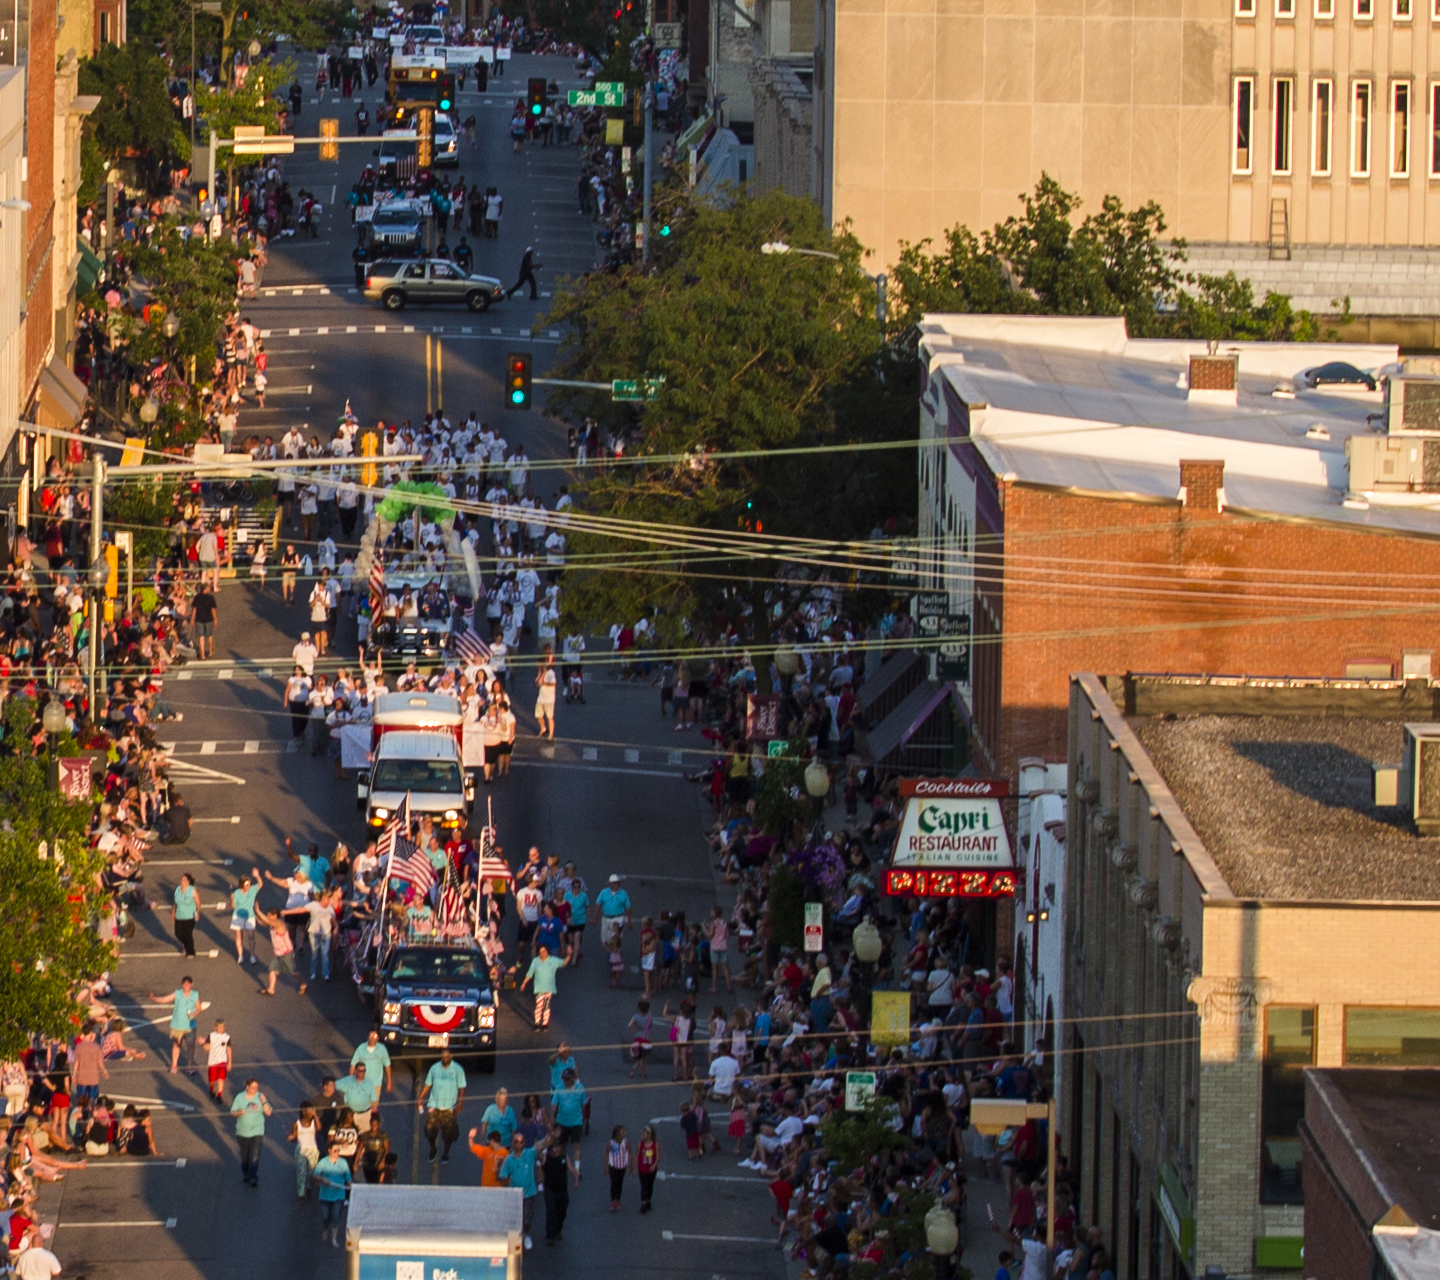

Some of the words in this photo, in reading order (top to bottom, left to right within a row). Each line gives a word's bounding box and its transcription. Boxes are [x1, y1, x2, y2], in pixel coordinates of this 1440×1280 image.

[576, 92, 596, 104] 2nd
[604, 92, 616, 104] St
[915, 781, 992, 794] Cocktails
[918, 805, 990, 835] Capri
[909, 836, 999, 851] RESTAURANT
[887, 870, 1017, 896] PIZZA
